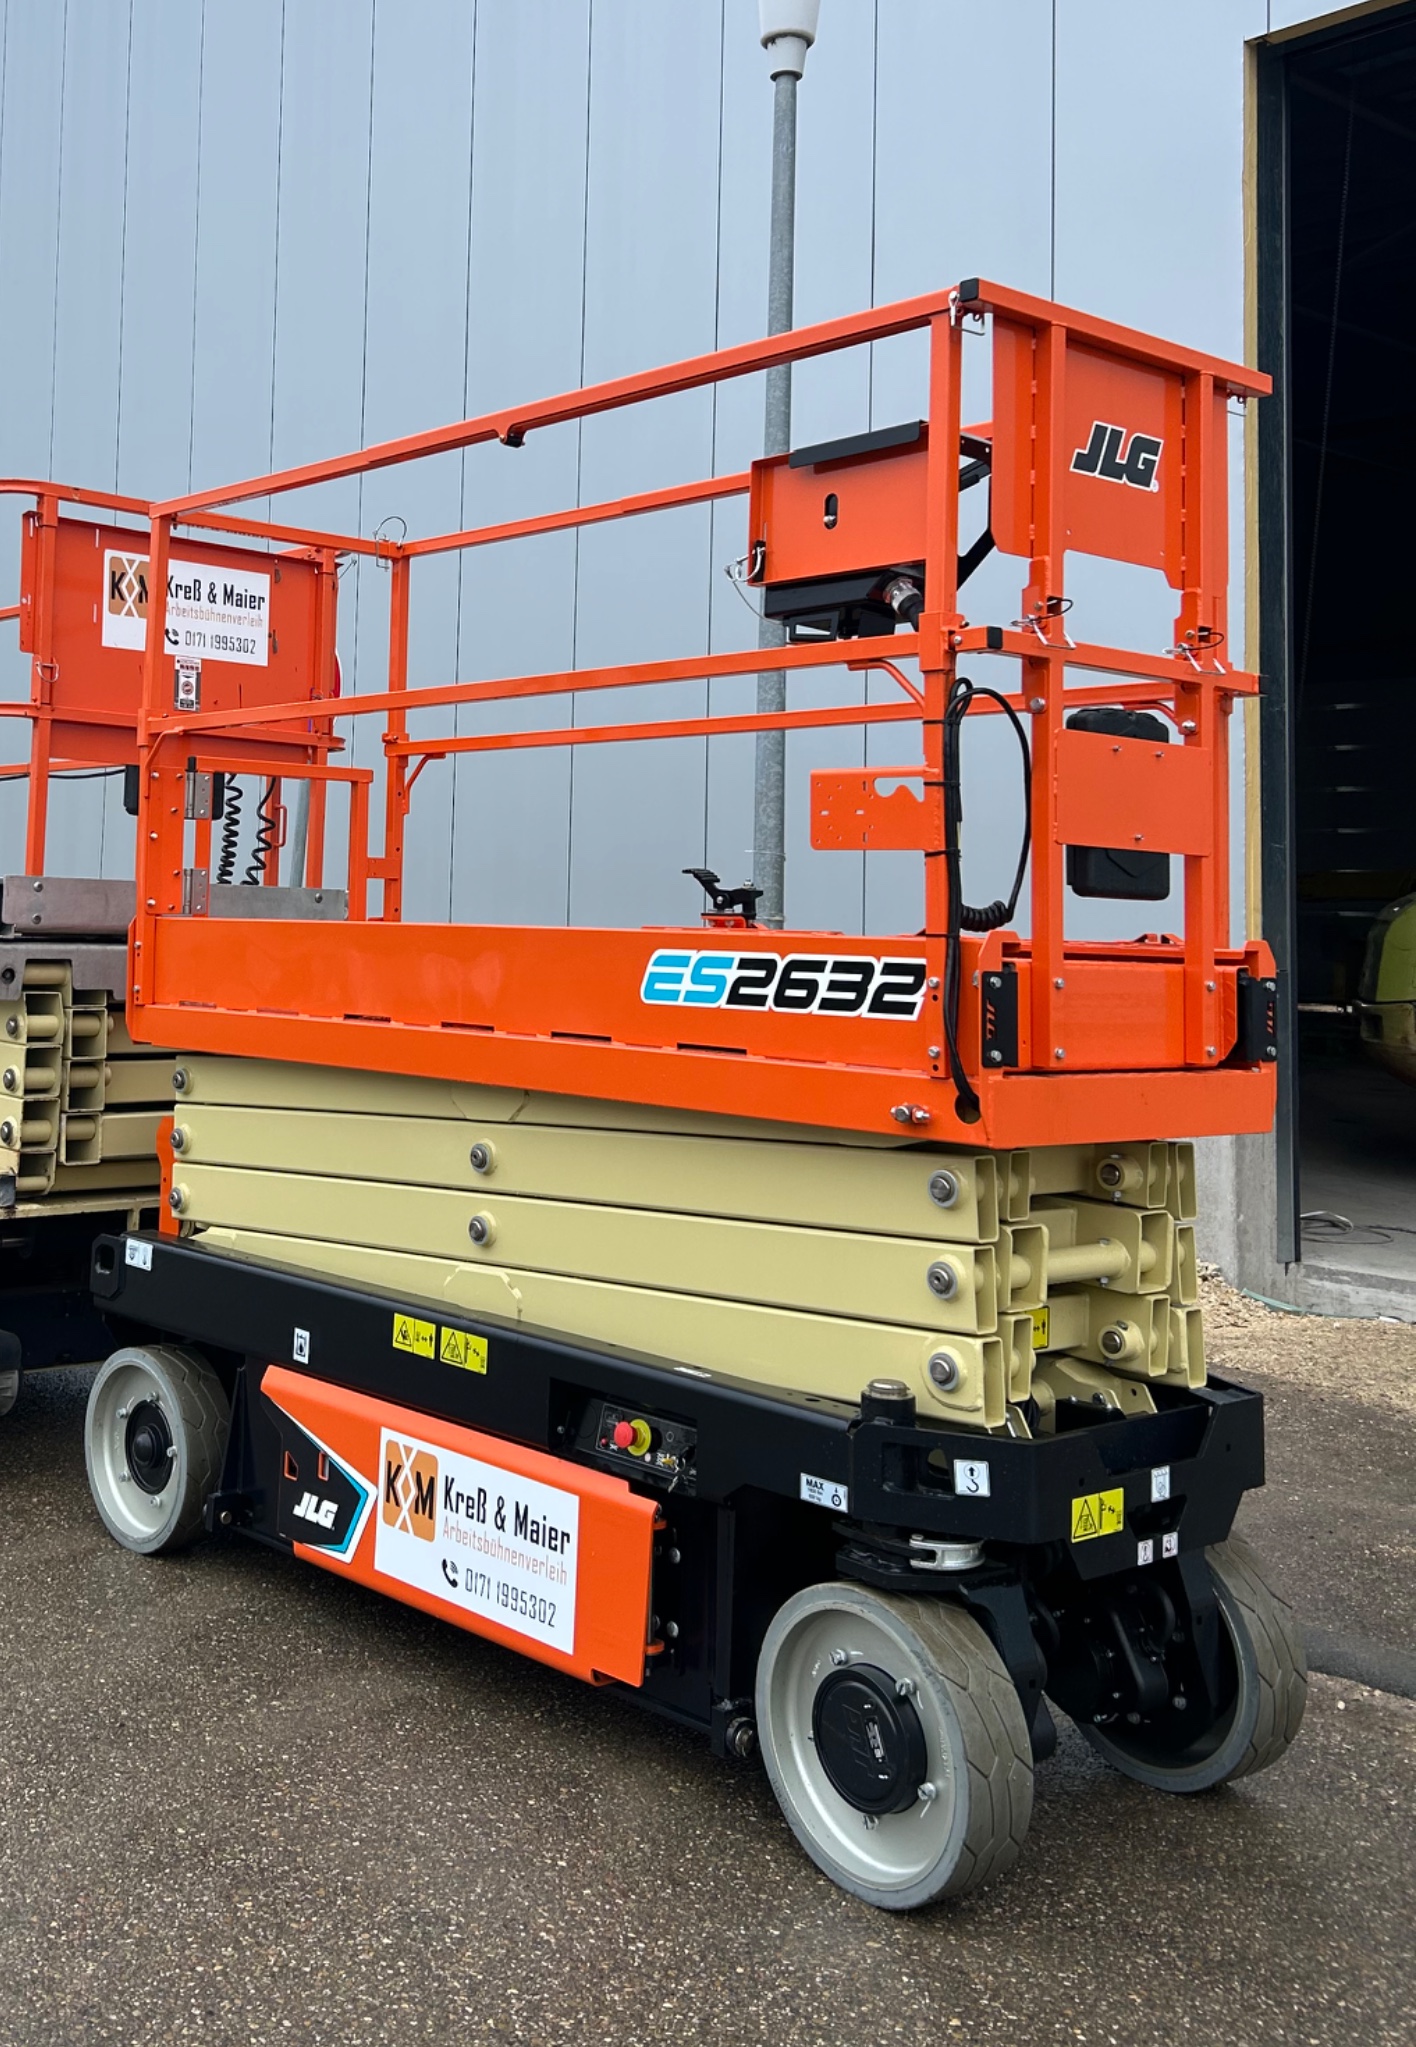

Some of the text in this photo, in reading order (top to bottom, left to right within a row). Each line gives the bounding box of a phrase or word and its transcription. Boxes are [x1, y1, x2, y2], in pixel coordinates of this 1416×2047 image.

[1070, 421, 1163, 491] JLG
[166, 575, 266, 611] Kreß & Maier
[185, 630, 256, 655] 0171 1995302
[643, 953, 927, 1016] ES2632
[292, 1491, 339, 1530] JLG
[444, 1474, 571, 1555] Kreß & Maier
[806, 1477, 824, 1491] MAX
[442, 1515, 567, 1586] Arbeitsbühnenverleih
[465, 1567, 557, 1628] 0171 1995302
